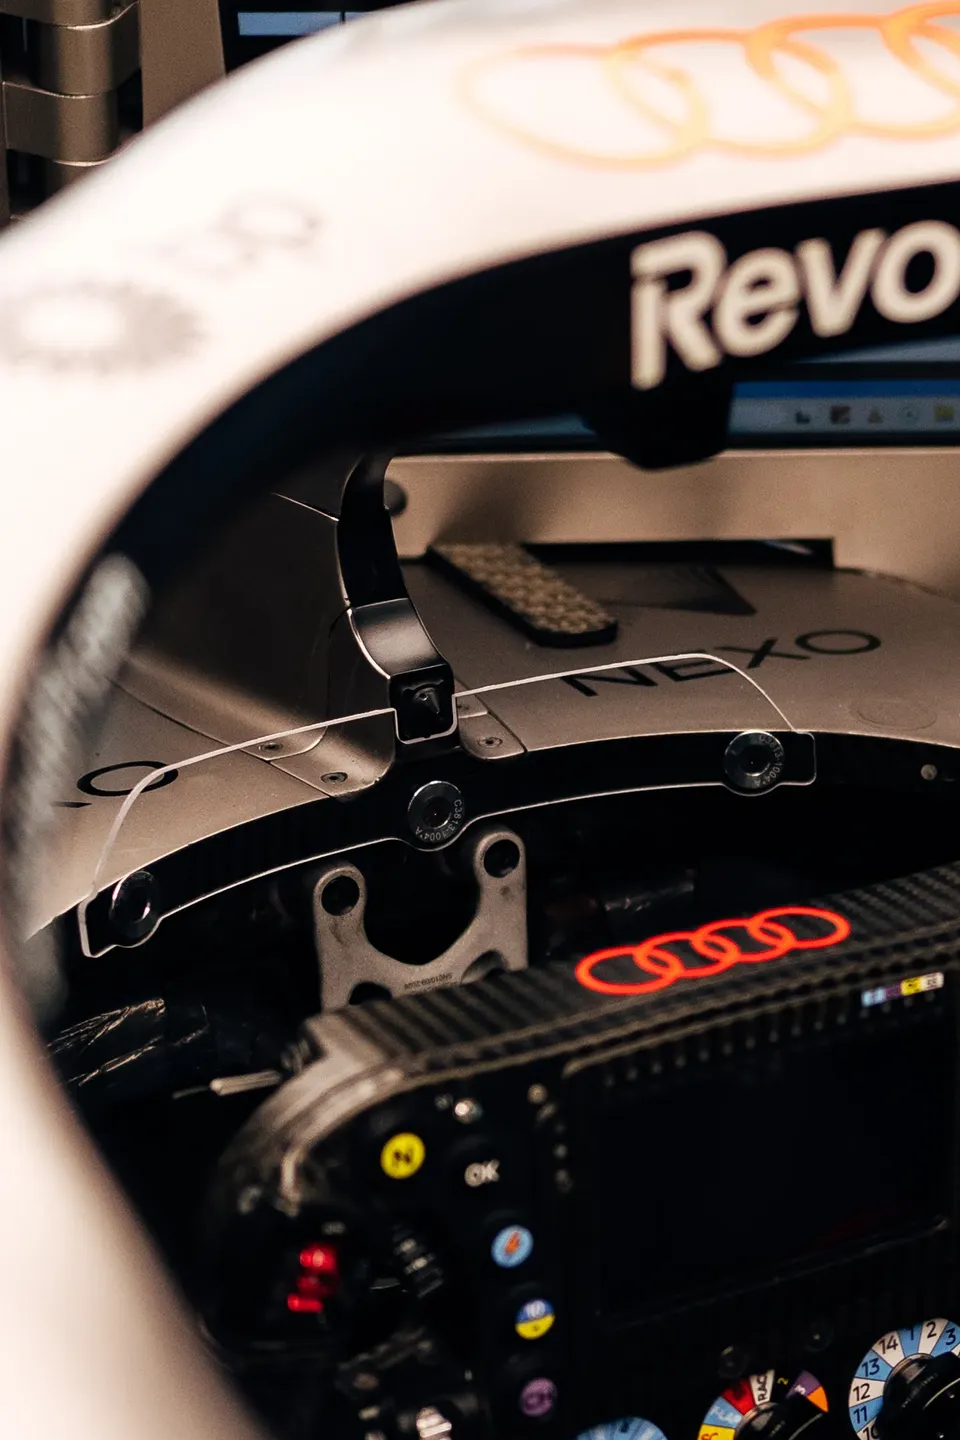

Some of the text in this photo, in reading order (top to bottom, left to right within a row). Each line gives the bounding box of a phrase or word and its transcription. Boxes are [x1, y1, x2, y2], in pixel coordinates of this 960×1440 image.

[560, 629, 881, 697] NEXO
[464, 1158, 500, 1187] OK
[926, 1321, 937, 1339] 2
[945, 1328, 956, 1346] 3
[878, 1335, 899, 1355] 14
[861, 1357, 880, 1377] 13
[852, 1383, 871, 1402] 12
[853, 1405, 868, 1424] 11
